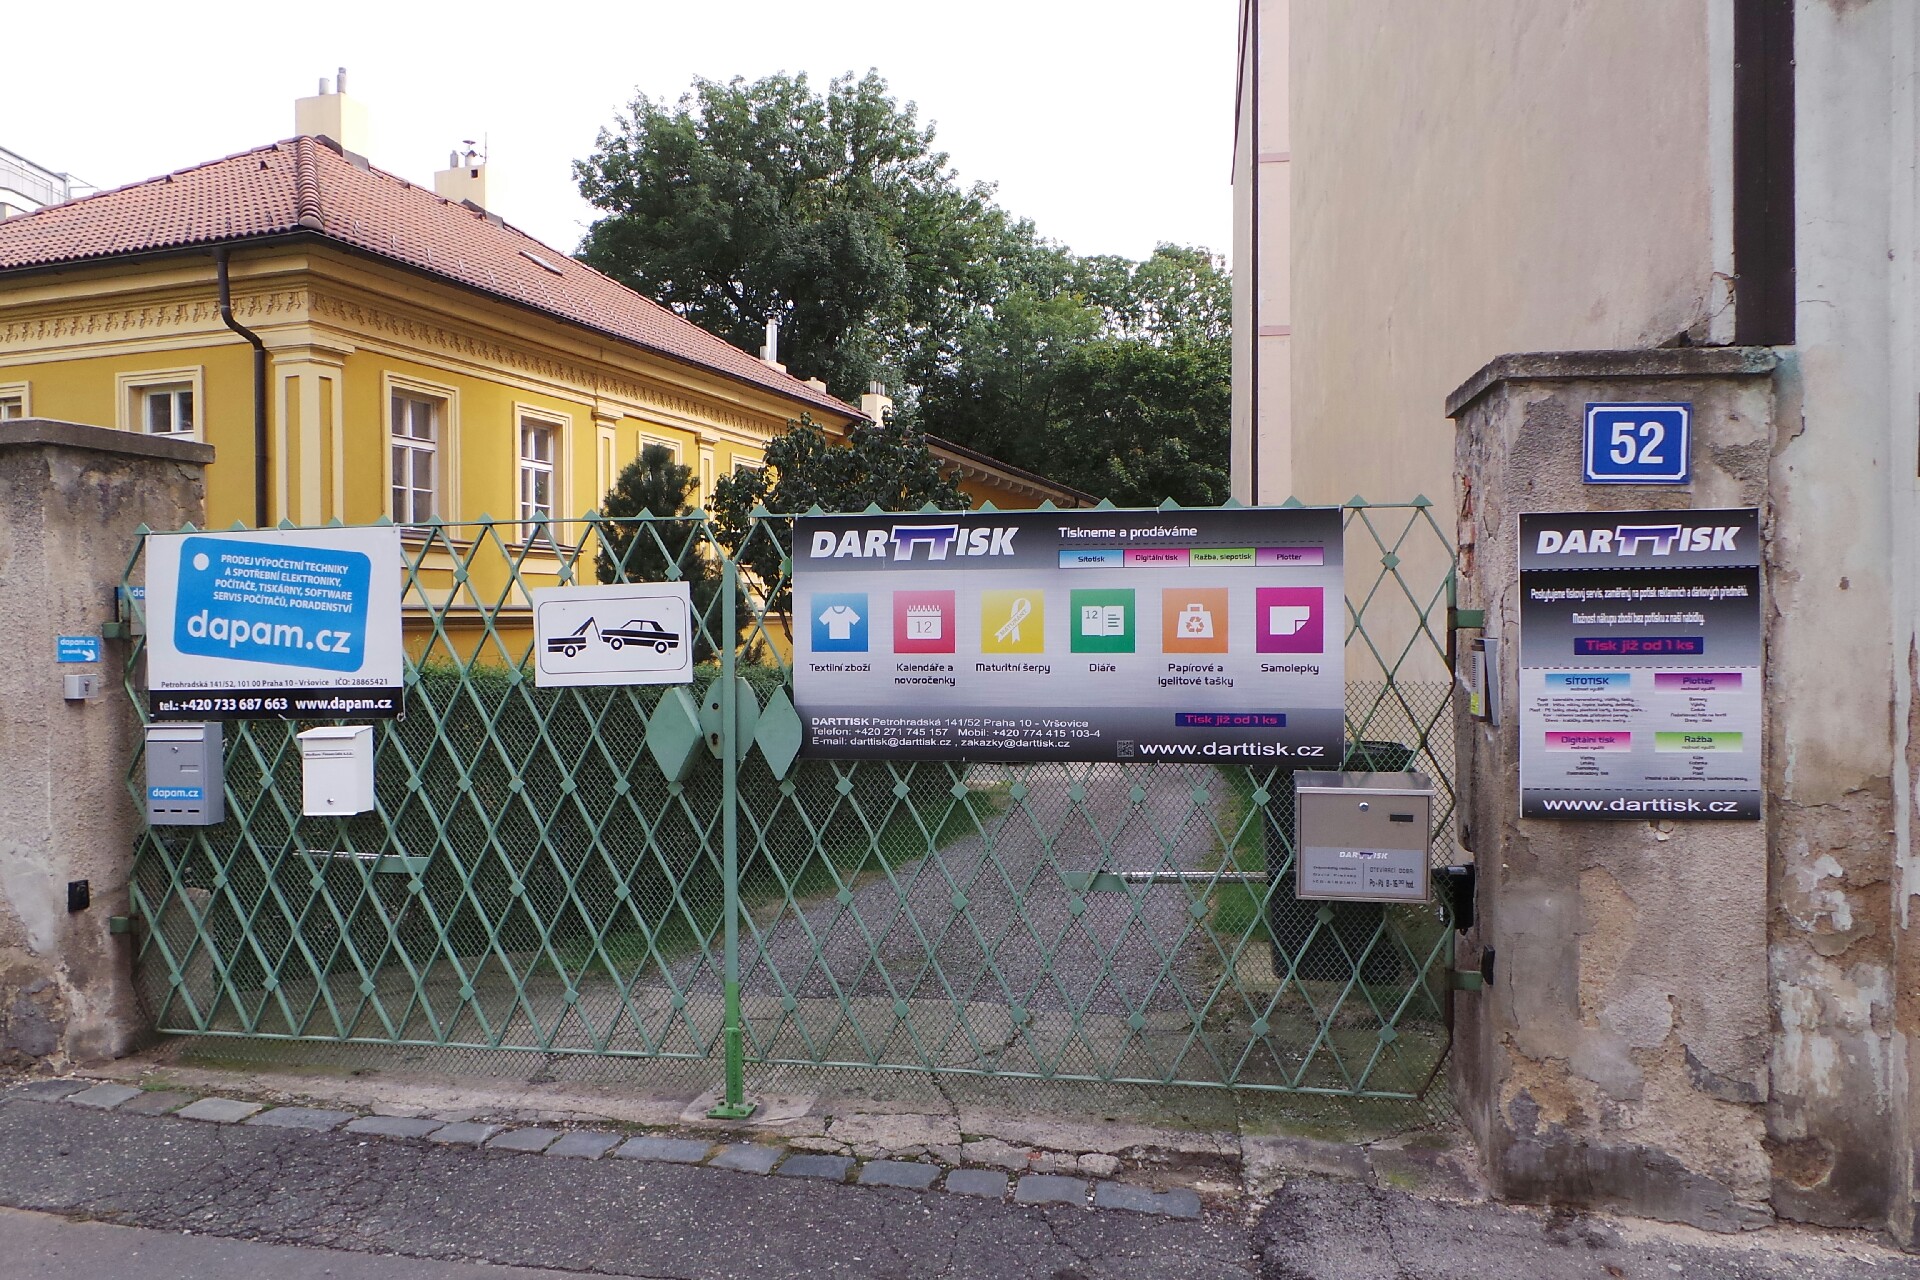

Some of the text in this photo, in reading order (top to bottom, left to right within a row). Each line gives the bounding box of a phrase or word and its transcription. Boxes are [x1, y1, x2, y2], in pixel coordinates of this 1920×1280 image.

[1609, 422, 1664, 465] 52
[1059, 526, 1198, 540] Tiskneme a prodáváme
[810, 524, 1019, 561] DARTTISK
[1536, 524, 1741, 556] DARTTISK
[1078, 552, 1302, 563] Sítotisk Digitální tisk Ražba, slepotisk Plotter
[221, 554, 348, 575] PRODEJ VÝPOČETNÍ TECHNIKY
[224, 566, 342, 588] A SPOTŘEBNÍ ELEKTRONIKY,
[215, 578, 352, 600] POČÍTAČE, TISKÁRNY, SOFTWARE
[214, 591, 352, 613] SERVIS POČÍTAČŮ, PORADENSTVÍ
[1086, 610, 1098, 619] 12
[187, 610, 351, 654] dapam.cz
[916, 621, 932, 633] 12
[60, 638, 95, 647] dapam.cz
[1586, 640, 1694, 653] Tisk již od 1 ks
[810, 663, 871, 672] Textilní zboží
[896, 663, 945, 672] Kalendáře
[975, 663, 1051, 674] Maturitní šerpy
[1089, 663, 1116, 672] Diáře
[1168, 663, 1214, 674] Papírové
[1260, 663, 1320, 675] Samolepky
[161, 680, 208, 688] Petrohradská
[210, 680, 236, 688] 141/52,
[238, 680, 250, 688] 101
[285, 679, 294, 687] 10
[300, 678, 329, 686] Vršovice
[335, 678, 350, 686] IČO:
[352, 678, 388, 686] 28865421
[894, 676, 956, 686] novoročenky
[1158, 676, 1234, 688] igelitové tašky
[1565, 676, 1609, 685] SÍTOTISK
[1682, 677, 1713, 685] Plotter
[159, 697, 392, 712] tel.: +420 733 687 663 www.dapam.cz
[812, 717, 869, 726] DARTTISK
[872, 718, 941, 726] Petrohradská
[944, 718, 980, 727] 141/52
[984, 718, 1016, 727] Praha
[1019, 719, 1032, 727] 10
[1042, 719, 1088, 728] Vršovice
[1185, 715, 1278, 725] Tisk již od 1 ks
[812, 727, 1100, 738] Telefon: +420 271 745 157 Mobil: +420 774 415 103-4
[812, 737, 848, 746] E-mail:
[850, 737, 951, 747] darttisk@darttisk.cz
[960, 738, 1070, 749] zakazky@darttisk.cz
[1561, 736, 1596, 746] Digitální
[1684, 735, 1712, 743] Ražba
[1140, 742, 1324, 757] www.darttisk.cz
[152, 788, 199, 798] dapam.cz
[1543, 798, 1738, 813] www.darttisk.cz
